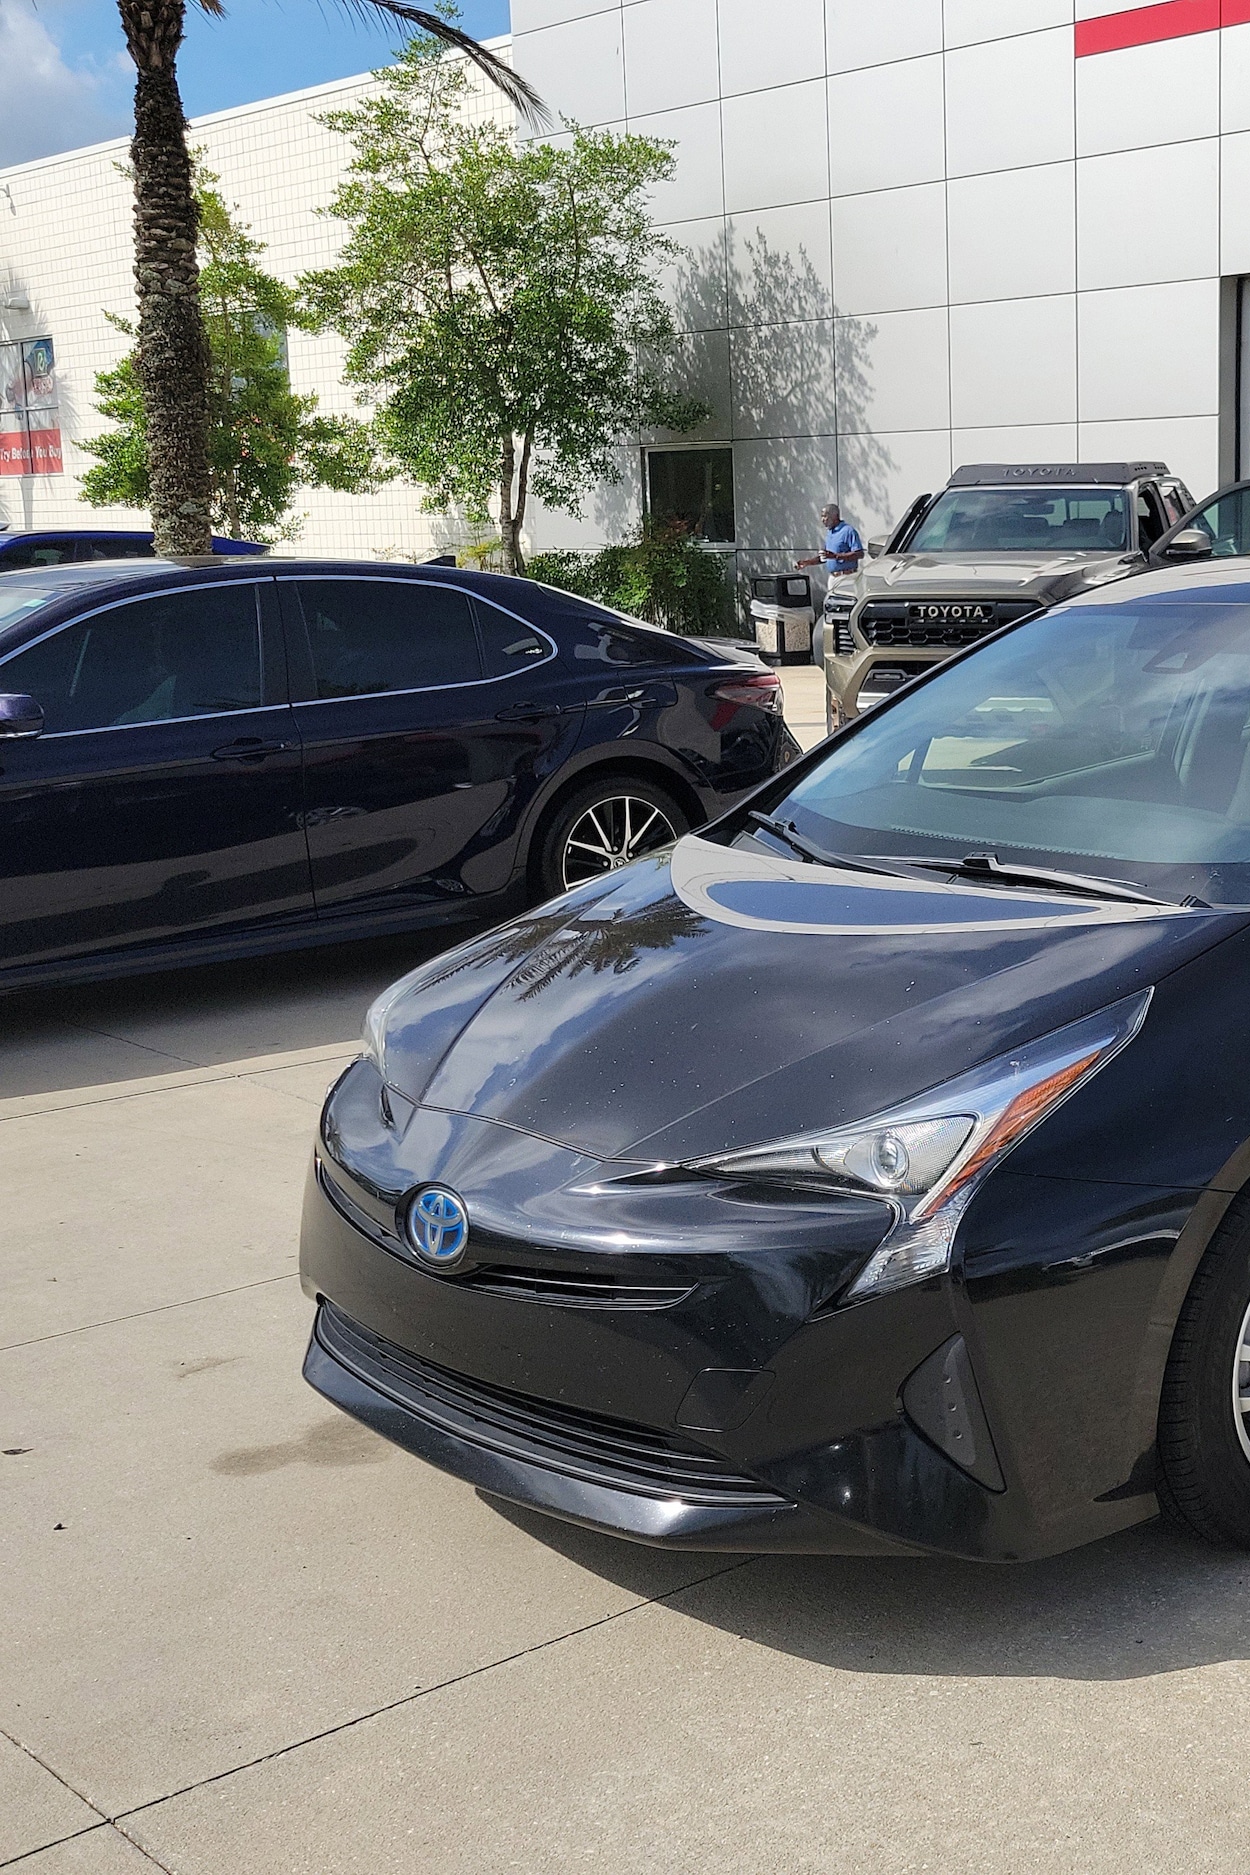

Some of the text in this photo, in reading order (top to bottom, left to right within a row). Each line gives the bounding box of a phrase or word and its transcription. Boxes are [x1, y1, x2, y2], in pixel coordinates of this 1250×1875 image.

[35, 445, 48, 459] You
[48, 444, 62, 460] Buy
[1002, 468, 1077, 477] TOYOTA
[917, 605, 985, 618] TOYOTA
